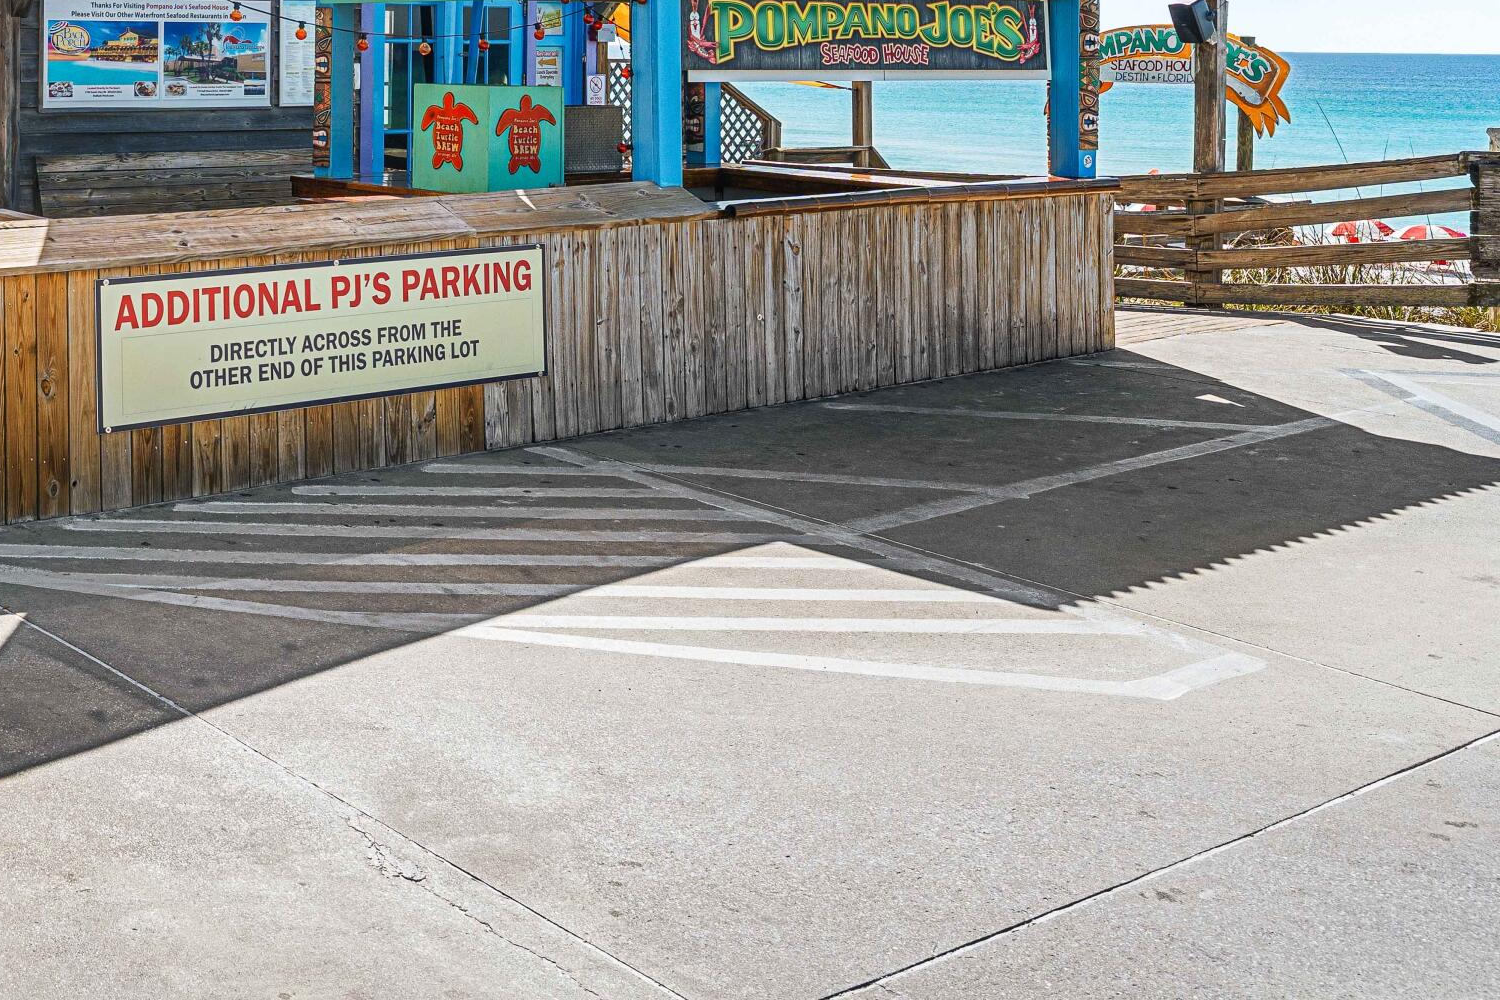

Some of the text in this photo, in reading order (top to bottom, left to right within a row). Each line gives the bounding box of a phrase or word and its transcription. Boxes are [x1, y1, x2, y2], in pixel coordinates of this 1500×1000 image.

[124, 2, 145, 10] Visiting
[146, 3, 172, 12] Pompano
[71, 10, 90, 18] Please
[919, 1, 1025, 62] JOE'S
[820, 43, 930, 66] SEAFOOD HOUSE
[1111, 60, 1163, 72] SEAFOOD
[1115, 72, 1149, 82] DESTIN
[436, 121, 459, 132] Beach
[513, 124, 538, 134] Beach
[436, 132, 458, 142] Turtle
[513, 135, 537, 144] Turtle
[436, 140, 459, 152] BREW
[514, 144, 538, 155] BREW
[114, 259, 532, 331] ADDITIONAL PJ'S PARKING
[210, 319, 462, 363] DIRECTLY ACROSS FROM THE
[189, 339, 480, 390] OTHER END OF THIS PARKING LOT
